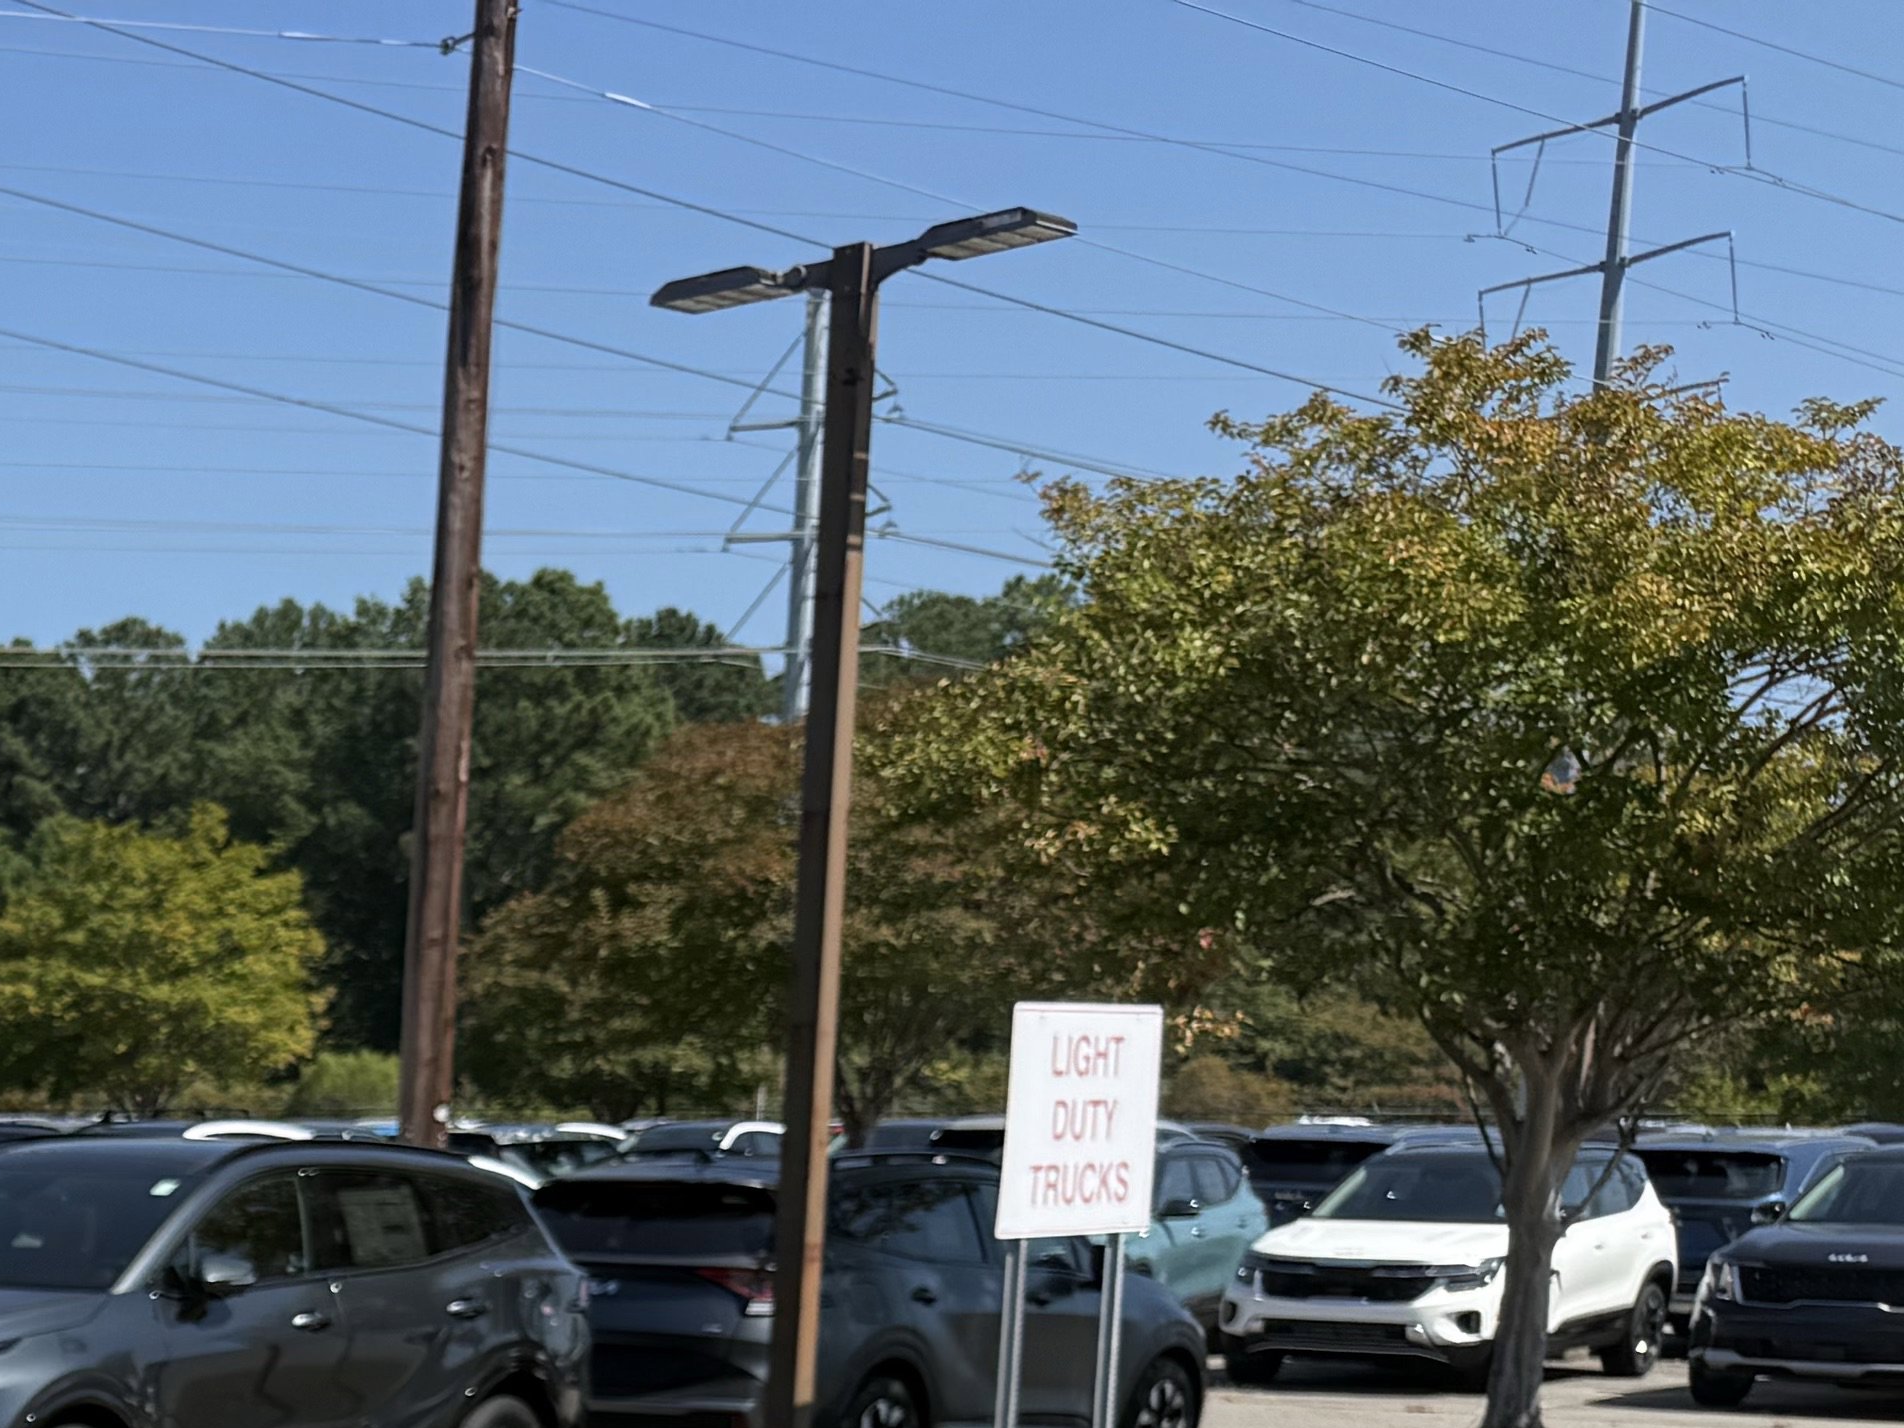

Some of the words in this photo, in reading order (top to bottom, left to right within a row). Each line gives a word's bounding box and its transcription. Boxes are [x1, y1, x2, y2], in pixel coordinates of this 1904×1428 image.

[1052, 1034, 1125, 1076] LIGHT
[1052, 1099, 1118, 1141] DUTY
[1030, 1161, 1129, 1207] TRUCKS
